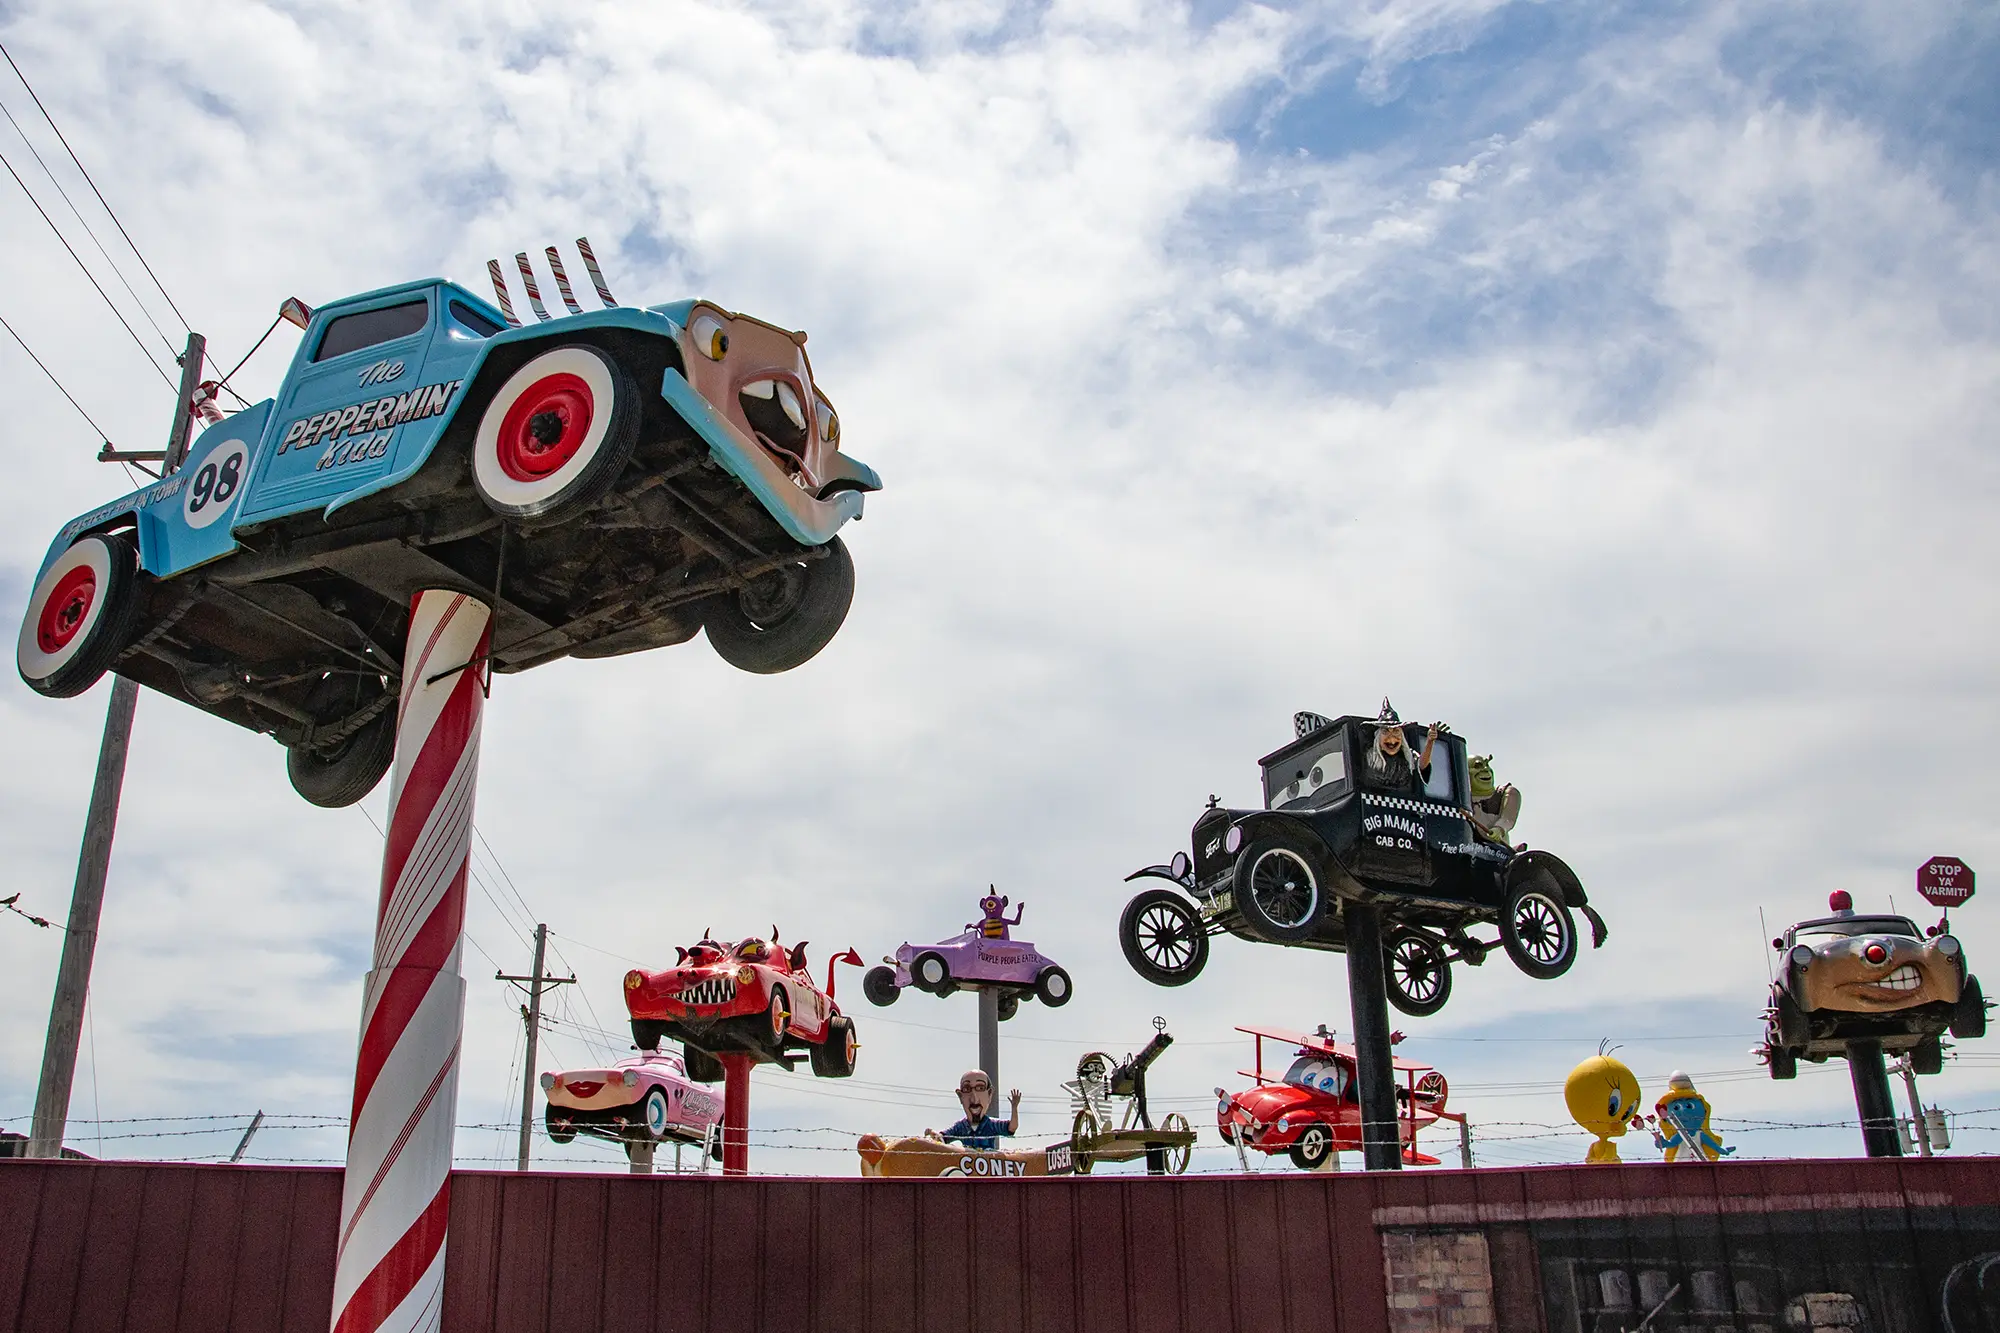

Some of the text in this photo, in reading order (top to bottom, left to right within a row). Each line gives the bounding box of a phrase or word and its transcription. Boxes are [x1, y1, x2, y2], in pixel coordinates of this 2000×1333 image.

[358, 359, 405, 388] The
[316, 428, 394, 471] Kidd
[190, 452, 243, 513] 98
[1364, 814, 1425, 840] BIG MAMA'S
[1375, 835, 1413, 850] CAB CO.
[1930, 864, 1962, 875] STOP
[1925, 886, 1968, 897] VARMIT!
[1938, 877, 1954, 886] YA'
[978, 951, 1038, 965] PURPLE PEOPLE EATER
[959, 1156, 1027, 1177] CONEY
[1047, 1145, 1072, 1172] LOSER
